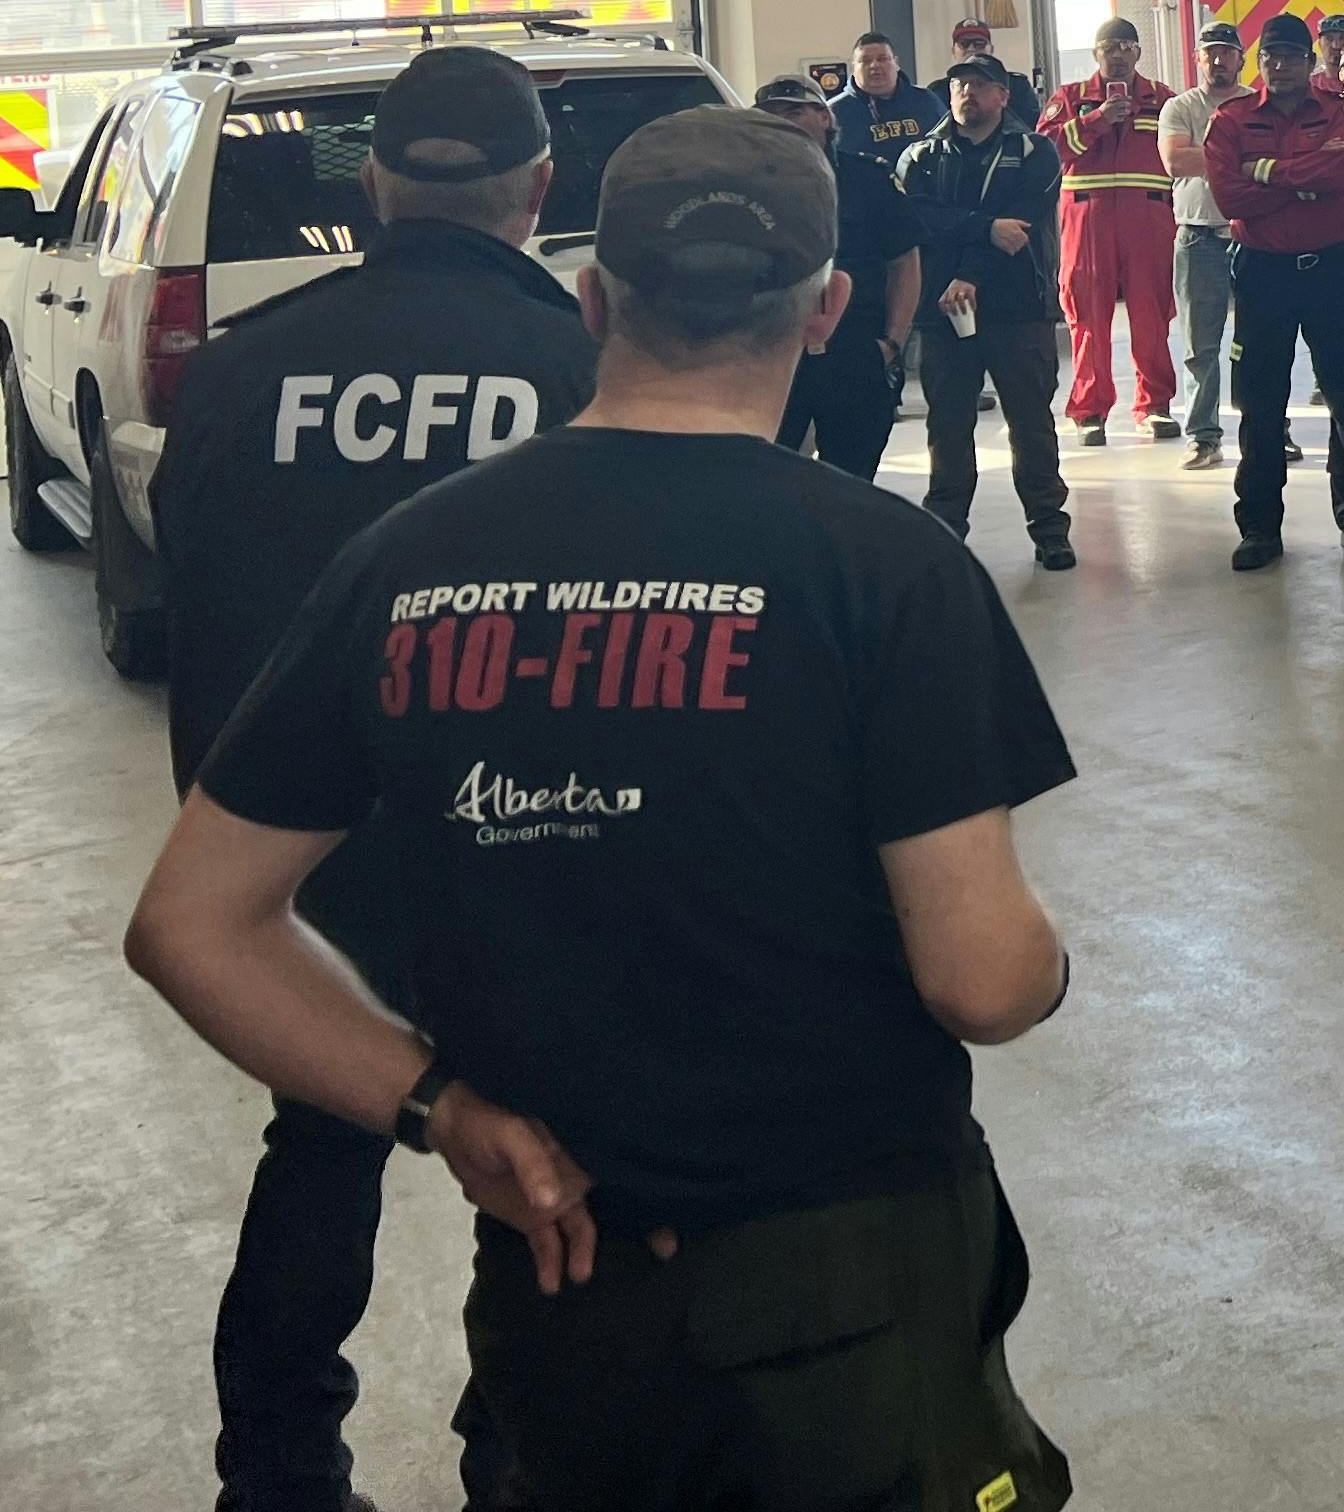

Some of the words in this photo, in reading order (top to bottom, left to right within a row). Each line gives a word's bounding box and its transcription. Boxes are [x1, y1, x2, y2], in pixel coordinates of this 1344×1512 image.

[870, 119, 920, 143] EFD
[274, 373, 539, 463] FCFD
[391, 581, 538, 623] REPORT
[546, 580, 766, 615] WILDFIRES
[378, 611, 759, 719] 310-FIRE
[444, 760, 628, 825] Alberta
